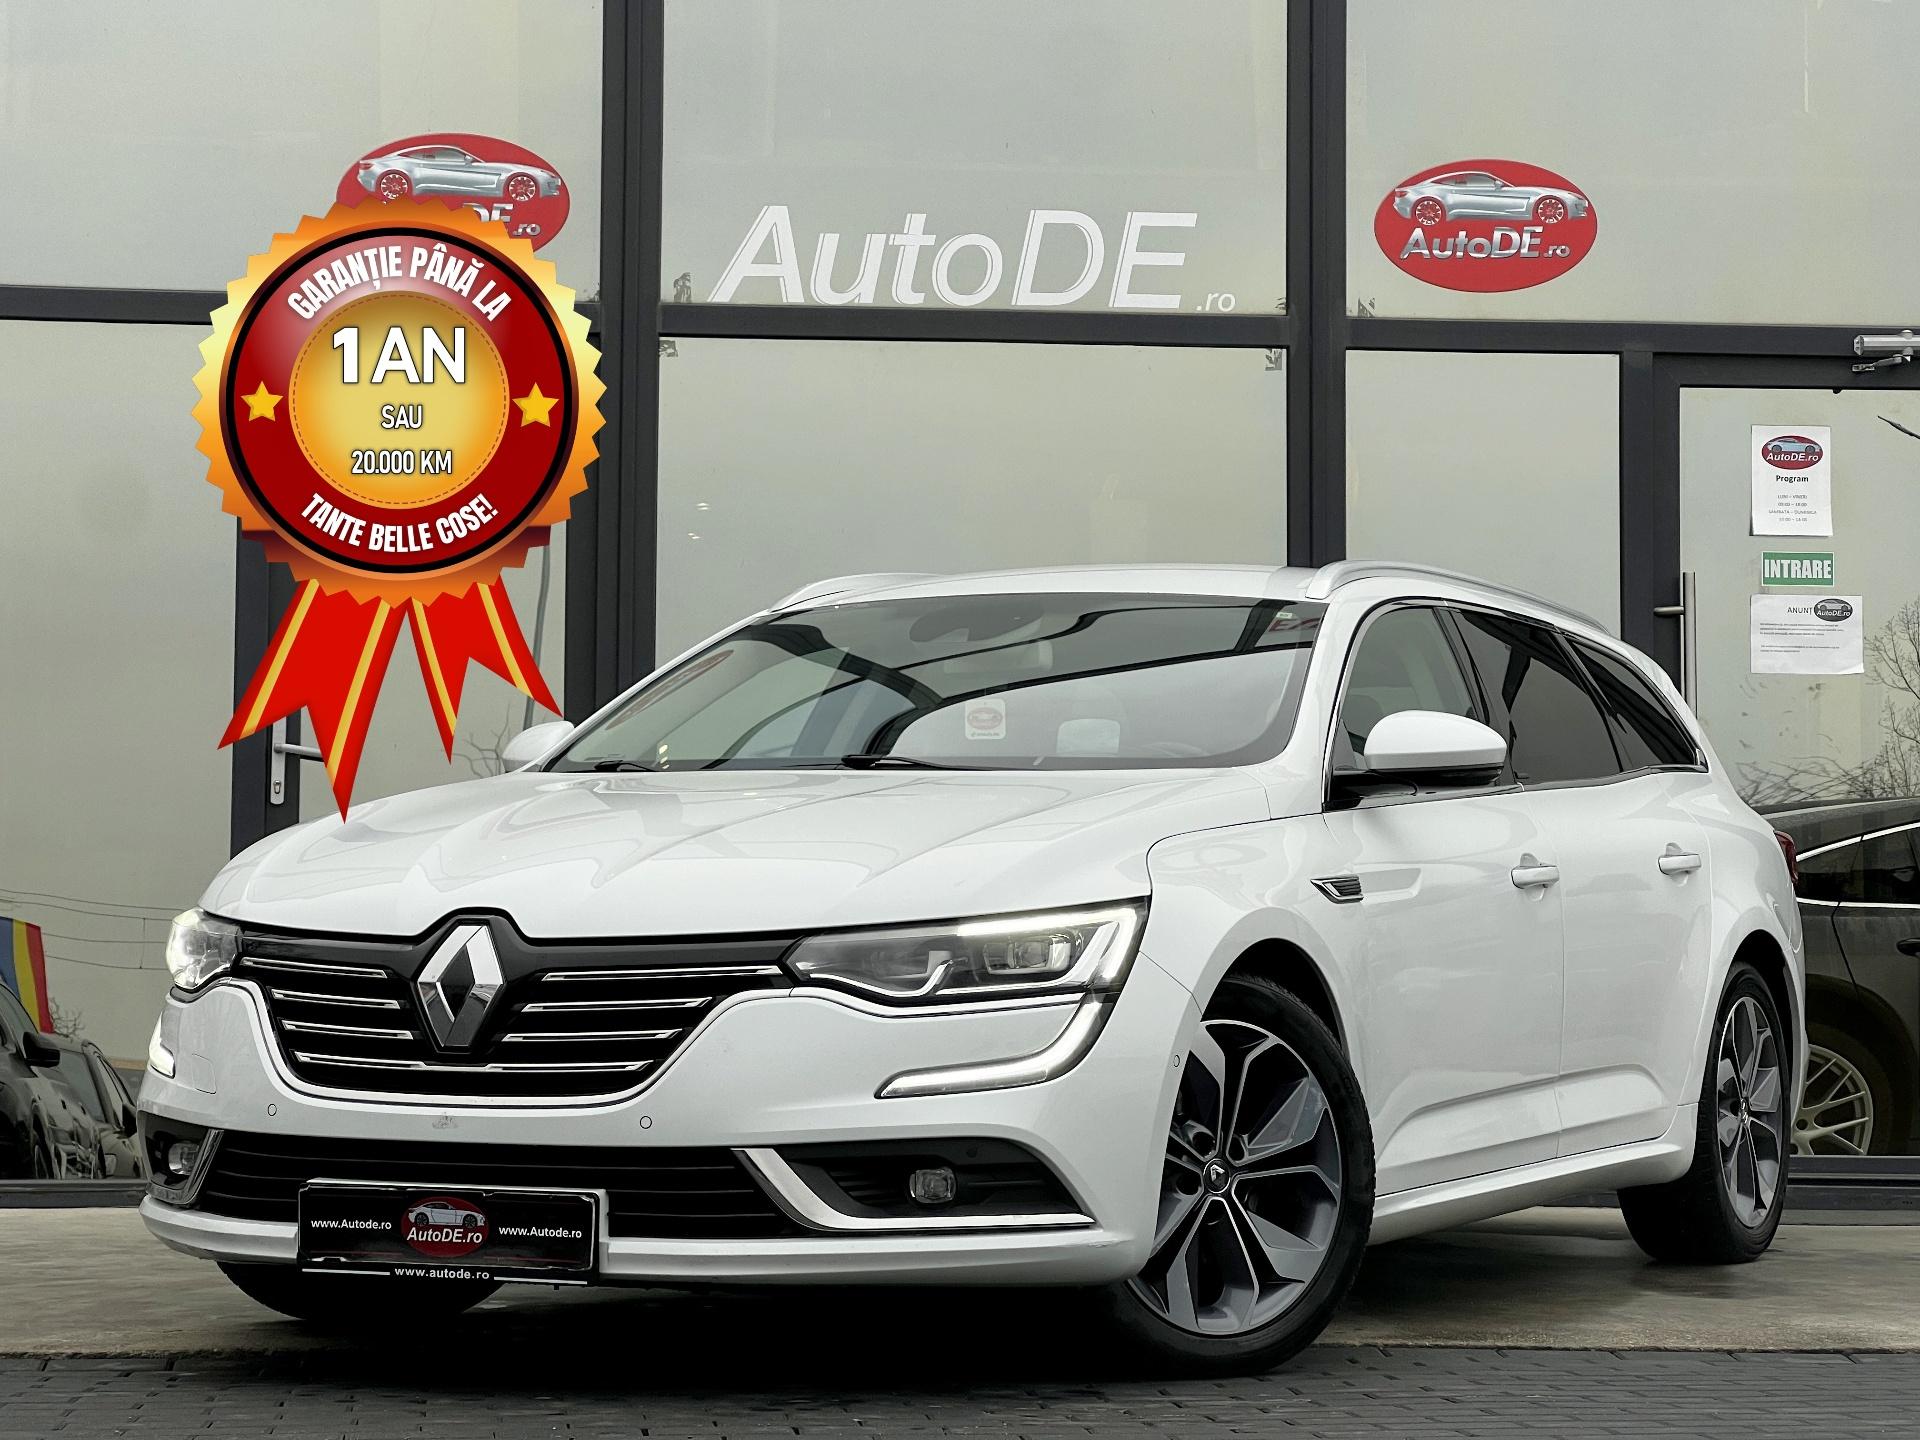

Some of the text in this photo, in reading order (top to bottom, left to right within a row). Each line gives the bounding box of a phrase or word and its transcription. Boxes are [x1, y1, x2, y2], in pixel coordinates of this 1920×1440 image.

[1766, 452, 1819, 462] AutoDE.ro
[1775, 474, 1809, 484] Program
[1764, 559, 1832, 579] INTRARE
[1816, 609, 1851, 617] AutoDE.ro
[310, 1218, 583, 1245] www.Autode.ro AutoDE.ro www.Autode.ro
[394, 1266, 490, 1280] www.autode.ro
